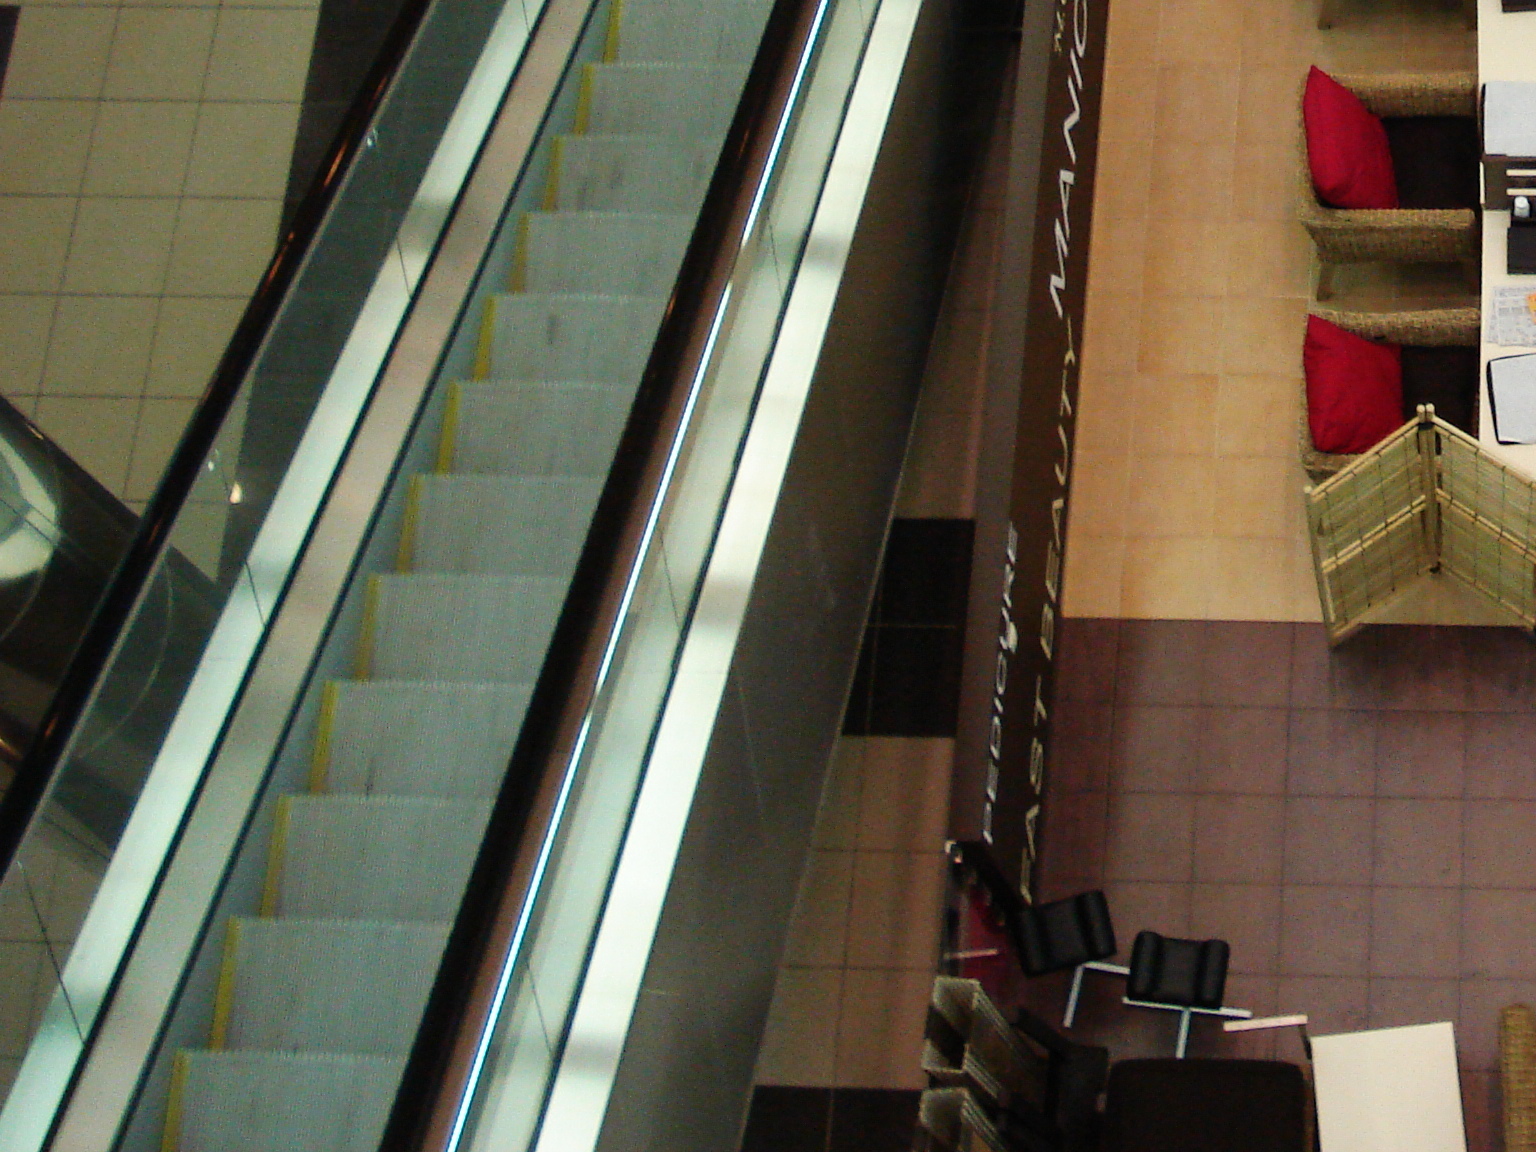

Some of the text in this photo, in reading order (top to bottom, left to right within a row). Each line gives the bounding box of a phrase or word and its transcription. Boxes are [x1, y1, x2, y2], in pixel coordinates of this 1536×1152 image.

[983, 519, 1019, 845] PEDICURE
[1020, 312, 1076, 905] FAST BEAUTY
